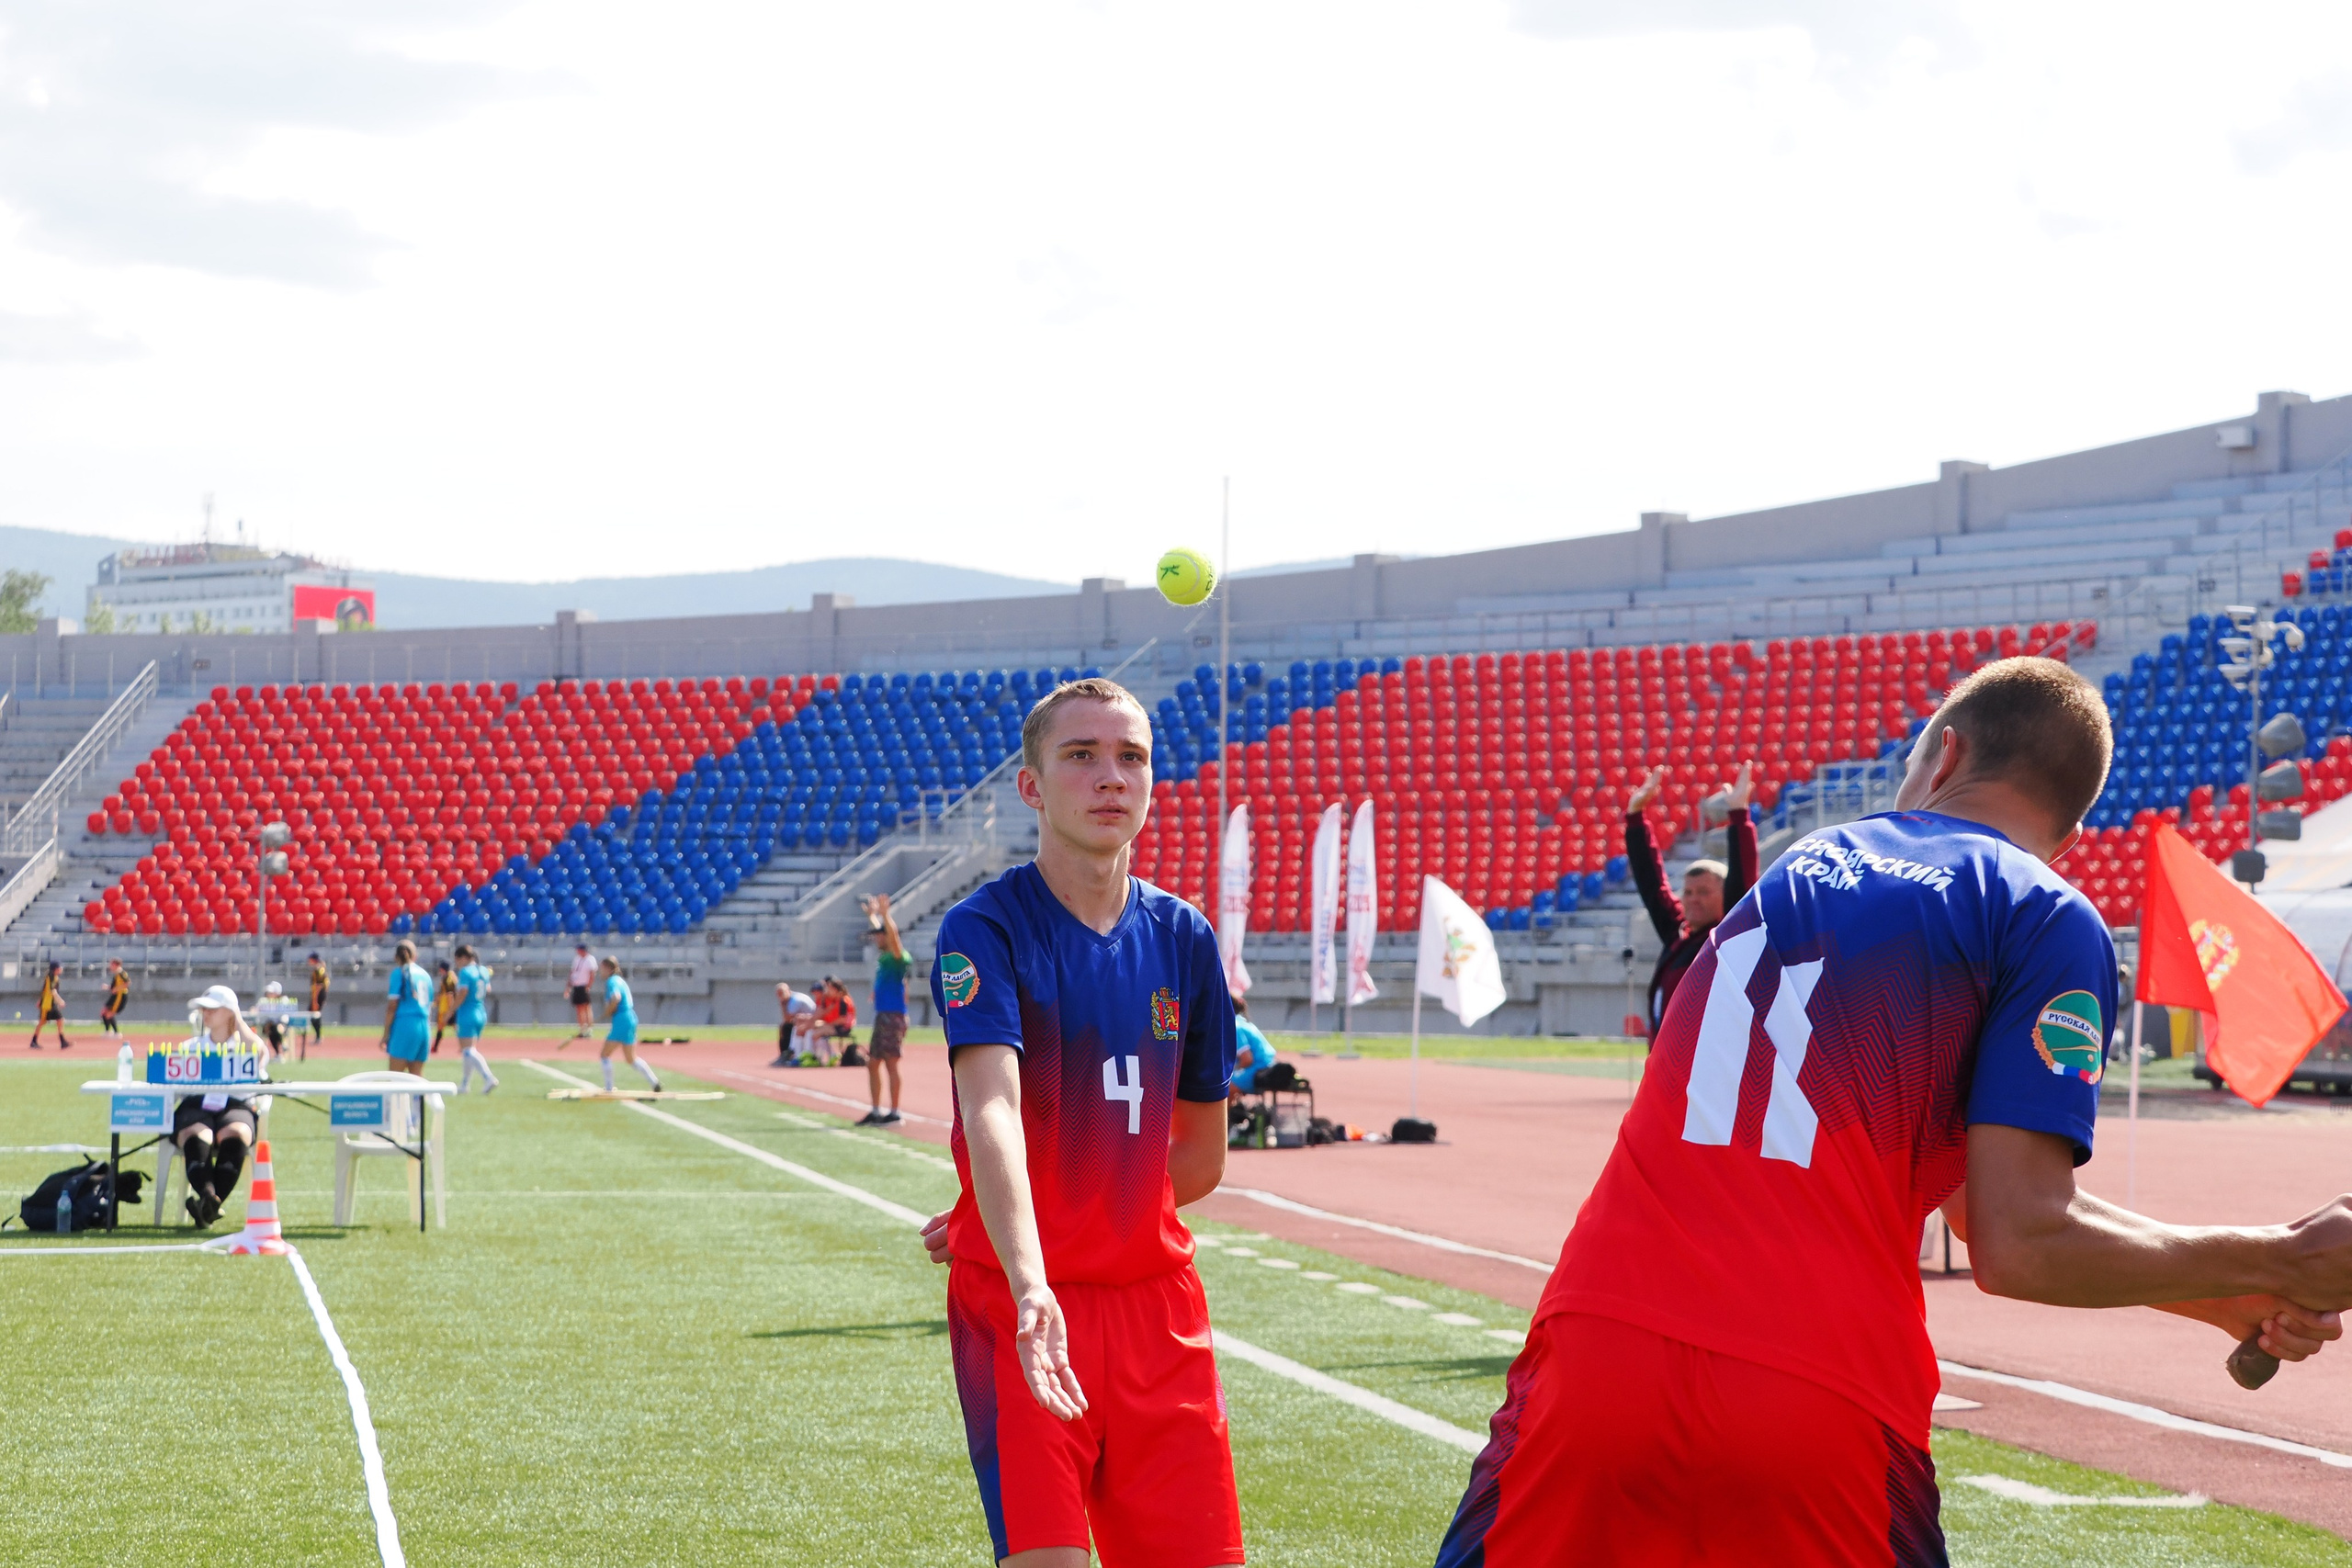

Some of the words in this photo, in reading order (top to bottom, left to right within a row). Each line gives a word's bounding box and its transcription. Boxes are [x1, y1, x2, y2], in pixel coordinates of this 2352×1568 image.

[1783, 838, 1956, 892] СНОЯРСКИЙ
[1786, 855, 1863, 891] КРАЙ
[1681, 921, 1826, 1169] 11
[2048, 1013, 2091, 1033] РУССКАЯ
[168, 1056, 200, 1078] 50
[229, 1056, 254, 1077] 14
[1102, 1055, 1145, 1134] 4
